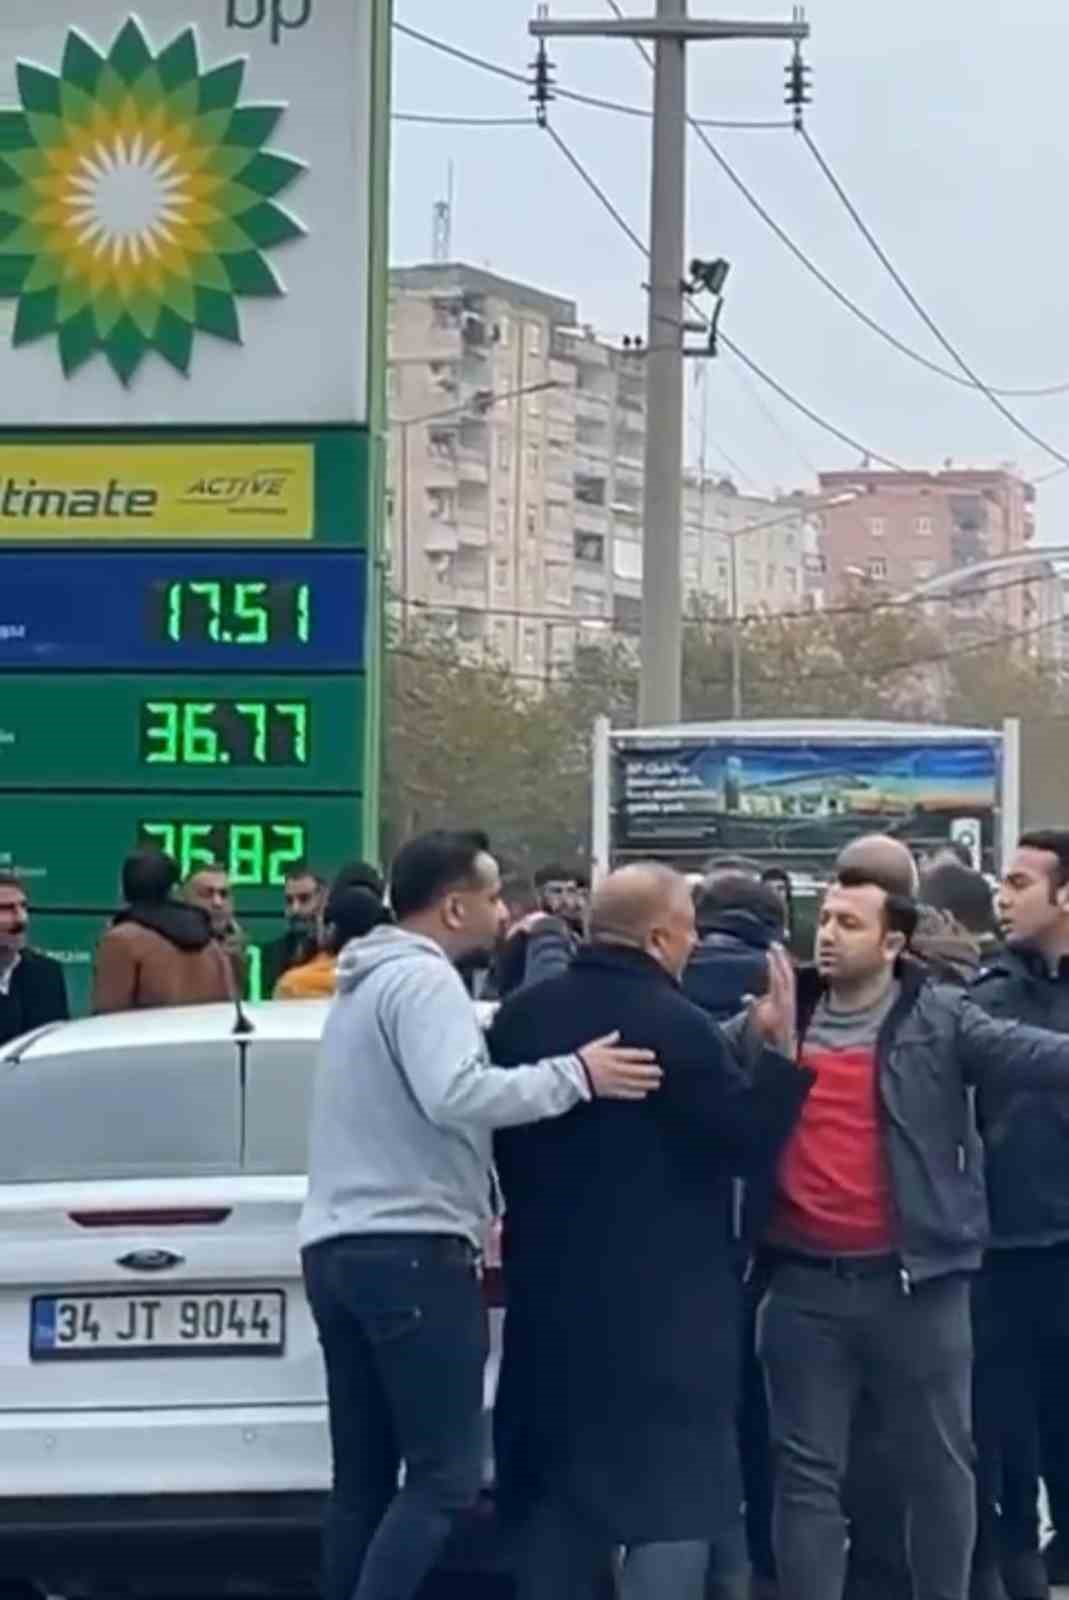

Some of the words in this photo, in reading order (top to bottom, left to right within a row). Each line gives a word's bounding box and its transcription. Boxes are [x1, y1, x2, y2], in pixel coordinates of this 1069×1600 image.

[226, 0, 312, 45] bp
[0, 478, 158, 519] timate
[184, 477, 288, 497] ACTIVE
[167, 583, 309, 643] 17.51
[145, 702, 307, 763] 36.77
[58, 1303, 101, 1343] 34
[116, 1301, 162, 1340] JT
[178, 1300, 271, 1339] 9044
